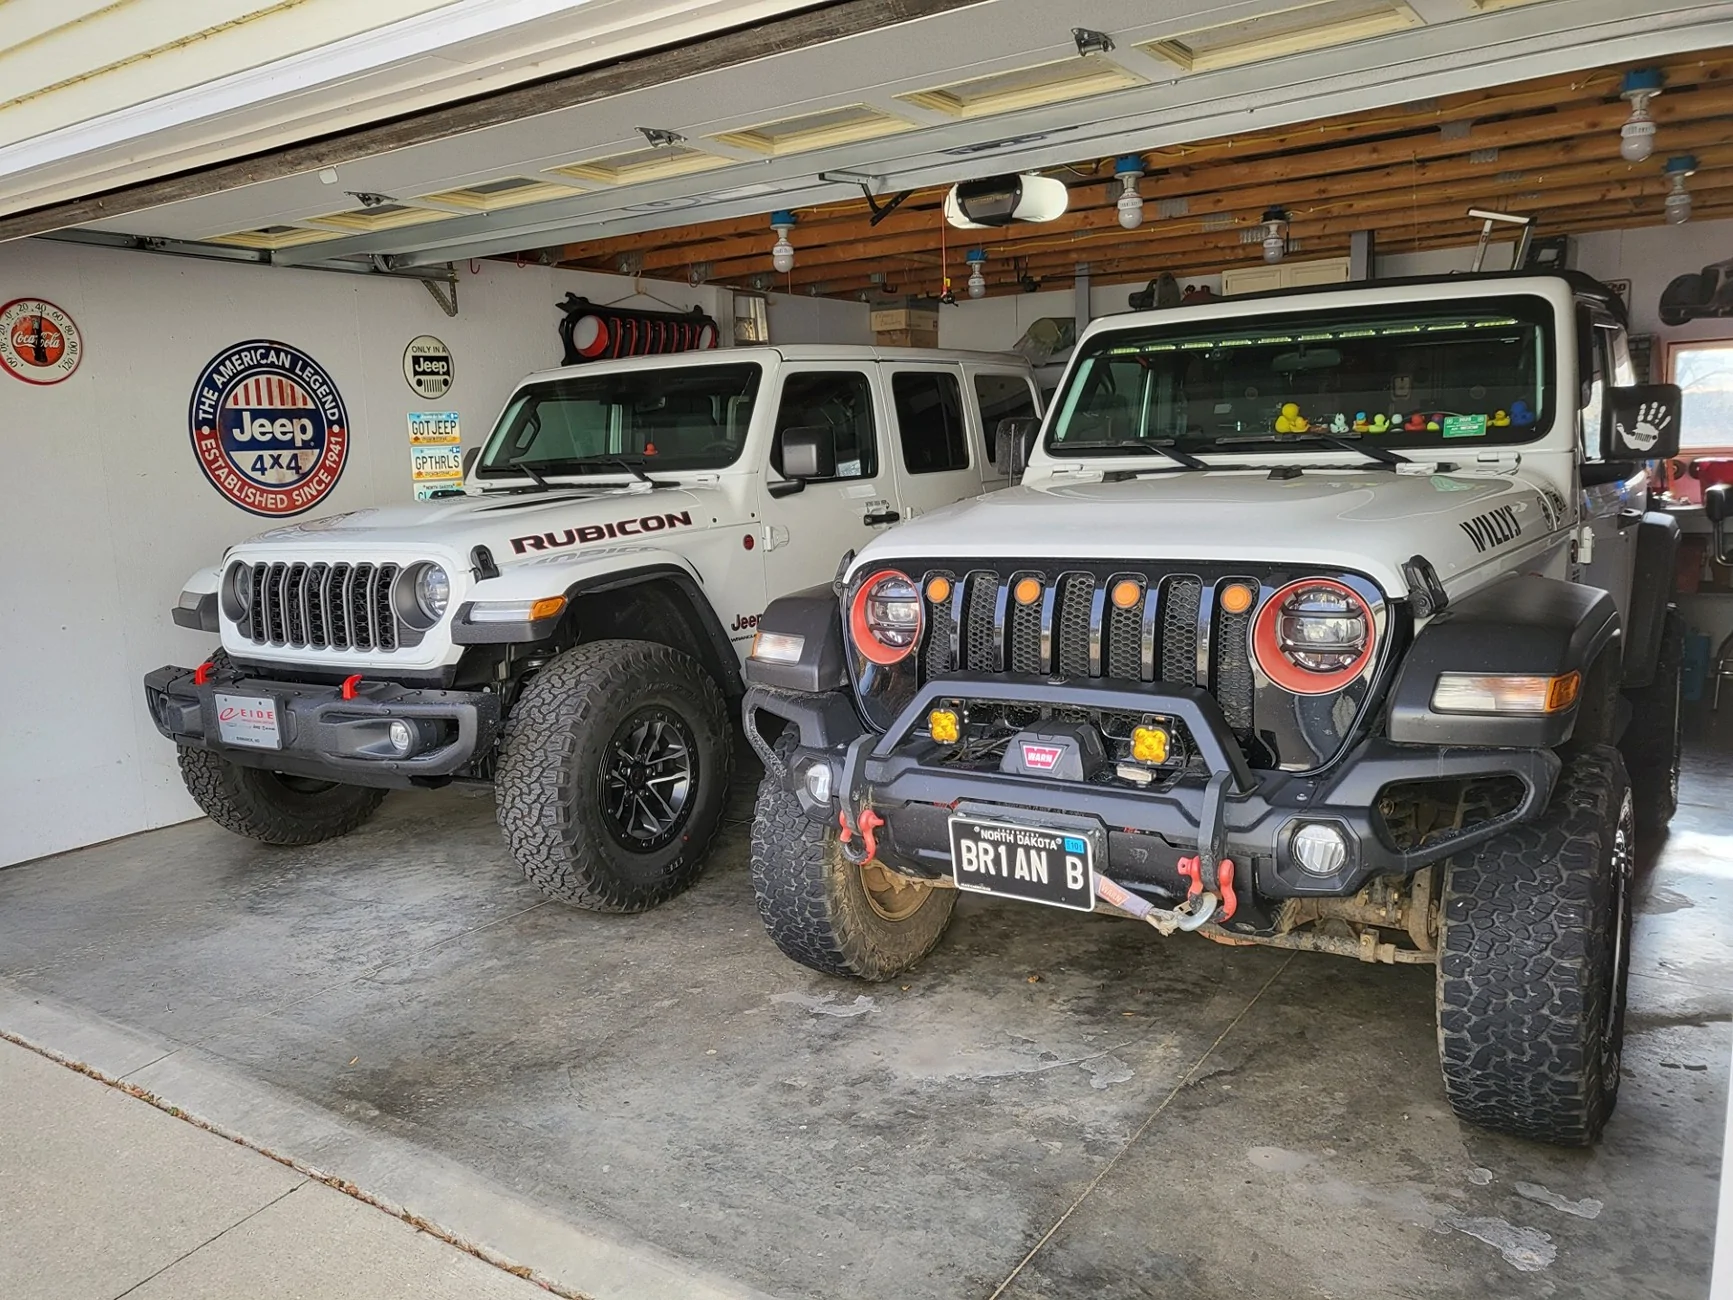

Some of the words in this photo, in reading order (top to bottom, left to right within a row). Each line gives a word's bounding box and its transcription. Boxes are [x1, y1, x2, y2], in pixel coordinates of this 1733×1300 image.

[17, 303, 28, 312] 20
[35, 303, 46, 312] 40
[52, 311, 63, 322] 60
[65, 325, 75, 336] 80
[69, 341, 78, 355] 100
[411, 345, 431, 353] ONLY
[442, 346, 447, 354] A
[62, 358, 75, 371] 120
[415, 357, 448, 375] Jeep
[199, 388, 219, 420] THE
[212, 349, 291, 388] AMERICAN
[295, 360, 340, 421] LEGEND
[232, 411, 313, 447] Jeep
[415, 455, 460, 470] GPTHRLS
[201, 439, 288, 509] ESTABLISHED
[292, 469, 331, 506] SINCE
[325, 436, 342, 469] 1941
[510, 510, 693, 554] RUBICON
[1459, 504, 1521, 553] WILLYS
[240, 709, 274, 720] EIDE
[1028, 752, 1054, 763] WARN
[981, 829, 1014, 843] NORTH
[1017, 834, 1058, 850] DAKOTA
[960, 839, 1049, 884] BR1AN
[1065, 855, 1084, 890] B
